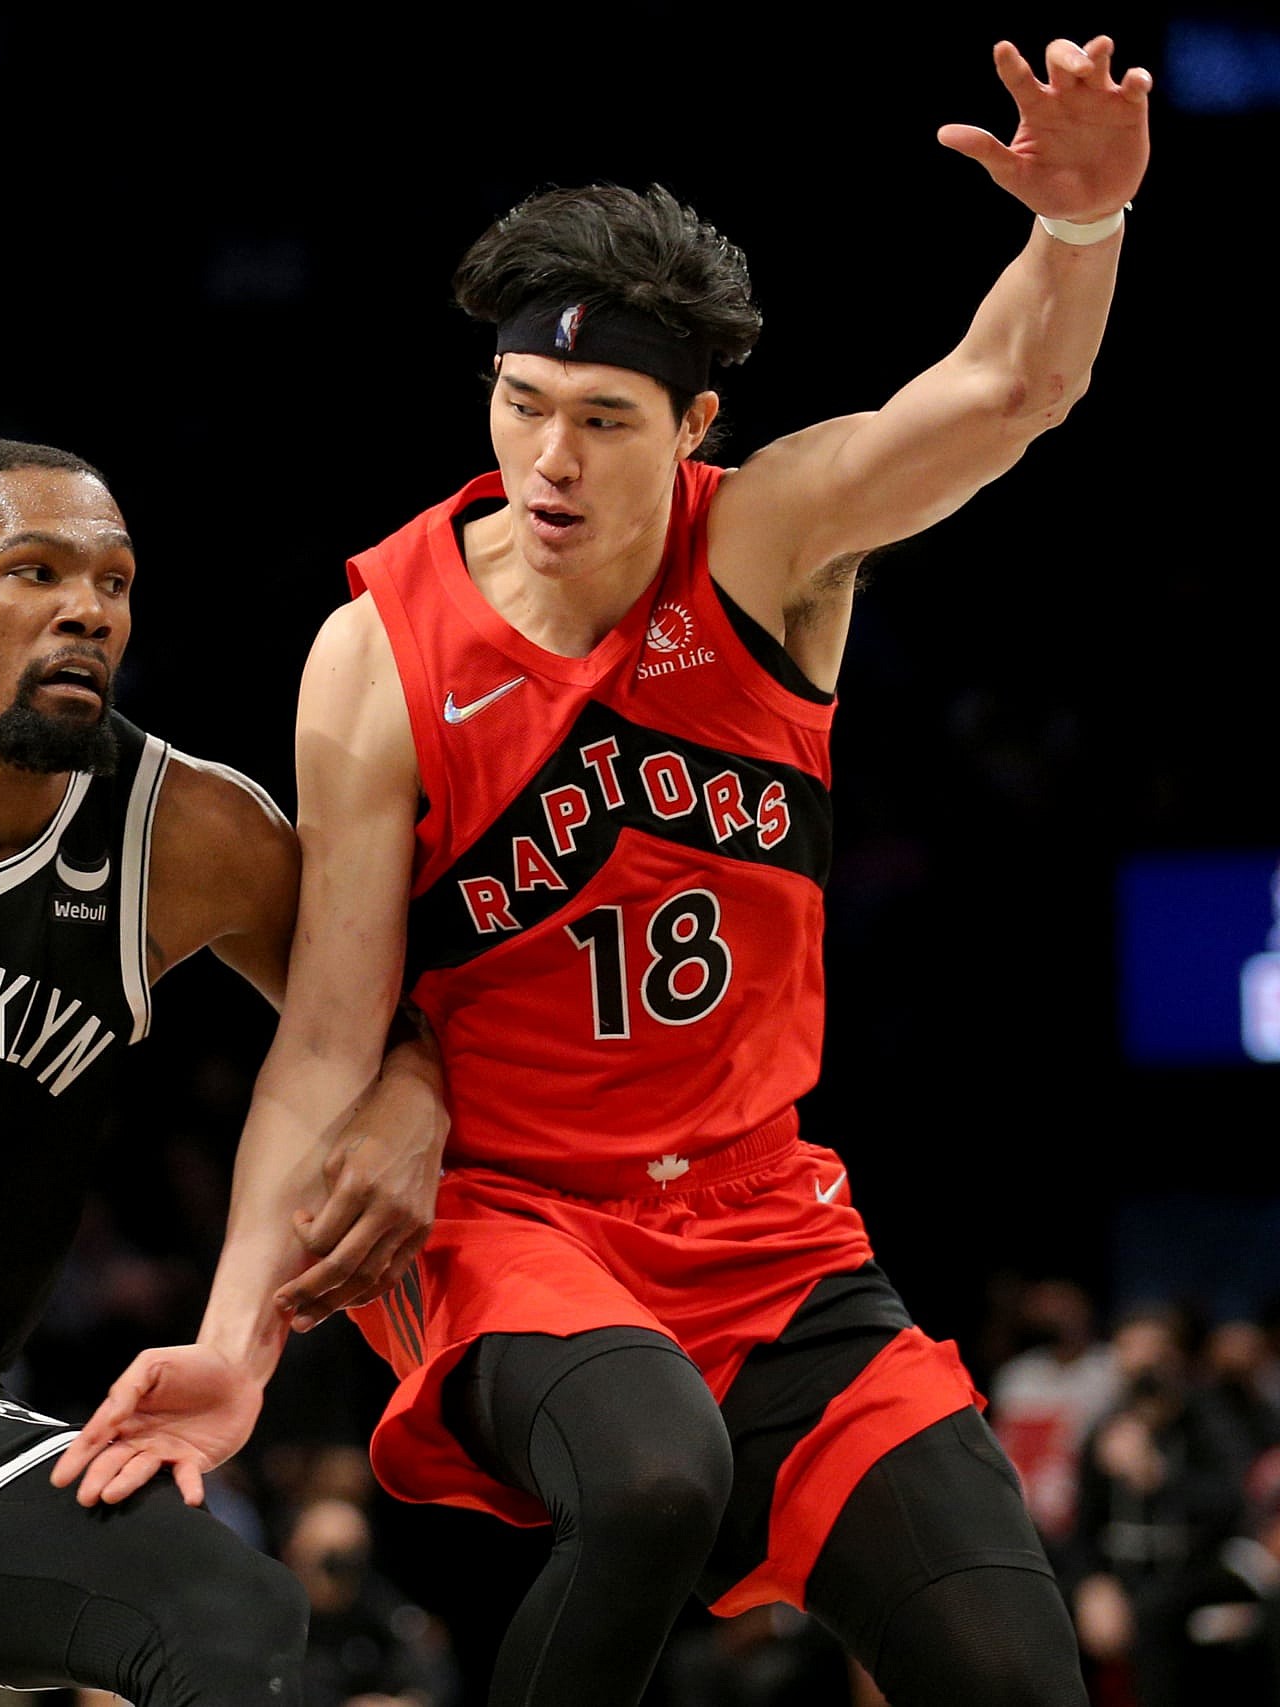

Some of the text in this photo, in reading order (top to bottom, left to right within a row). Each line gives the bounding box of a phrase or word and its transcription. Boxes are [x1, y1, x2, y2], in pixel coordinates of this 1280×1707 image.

[636, 646, 716, 680] Sun Life
[458, 735, 791, 935] RAPTORS
[53, 900, 107, 921] Webull
[563, 887, 733, 1041] 18
